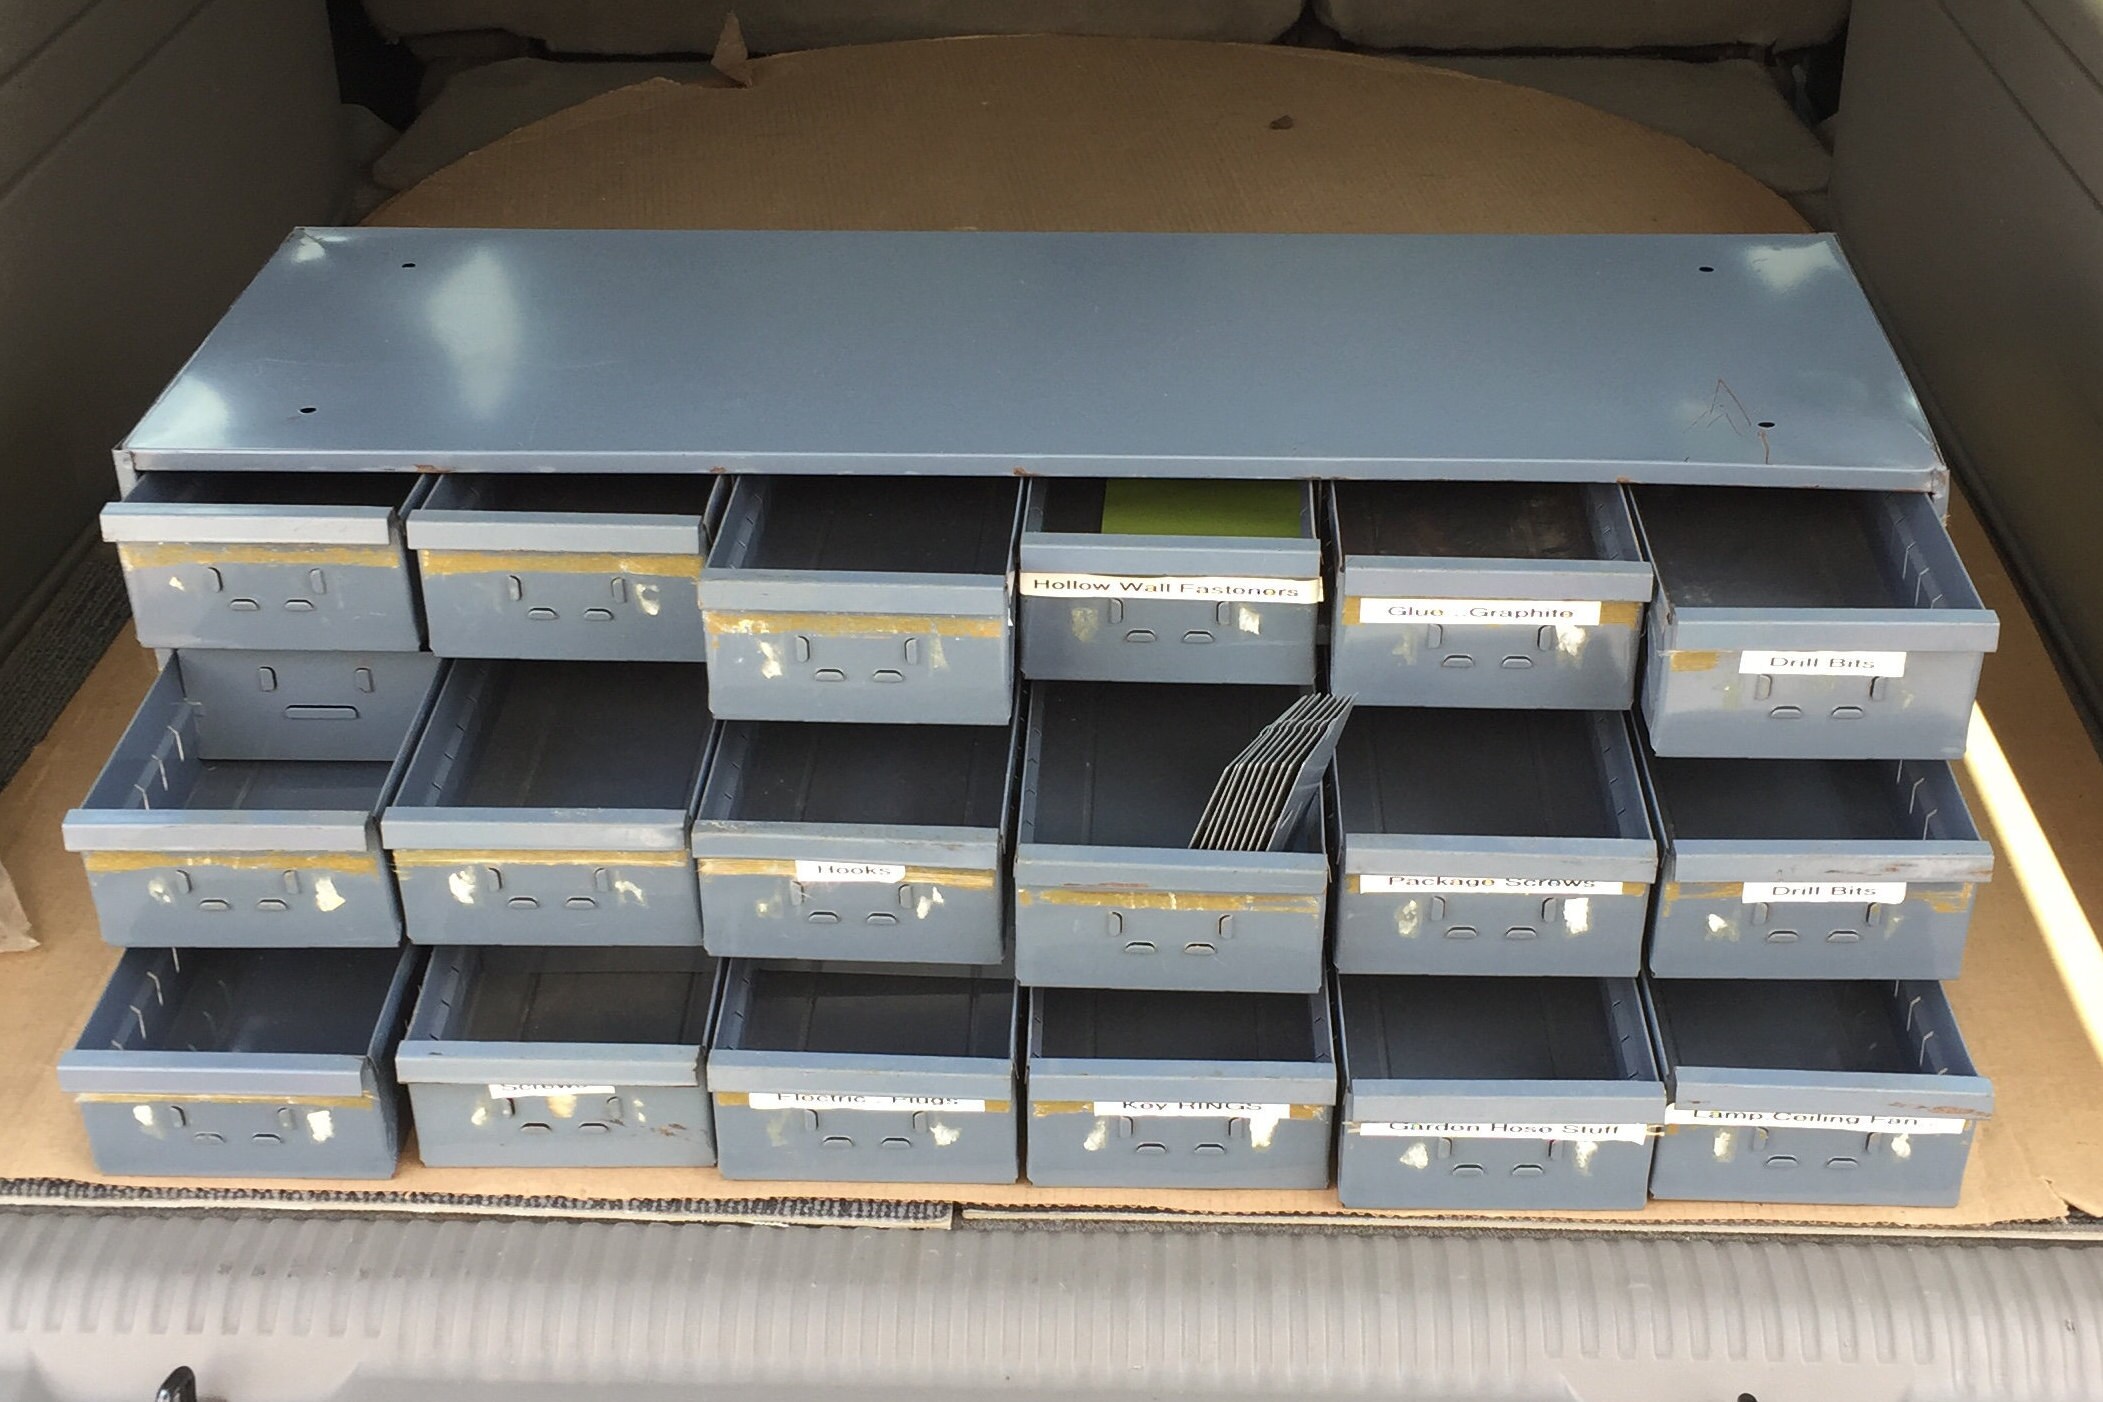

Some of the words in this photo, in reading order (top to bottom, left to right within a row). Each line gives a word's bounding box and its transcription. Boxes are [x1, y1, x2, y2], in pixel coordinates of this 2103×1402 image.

[1033, 578, 1111, 591] Hollow
[1120, 581, 1171, 593] Wall
[1770, 657, 1819, 667] Drill
[1829, 658, 1875, 669] Bits
[818, 865, 891, 875] Hooks
[1772, 886, 1820, 896] Drill
[1831, 886, 1876, 896] Bits
[1562, 1124, 1619, 1134] Stuff
